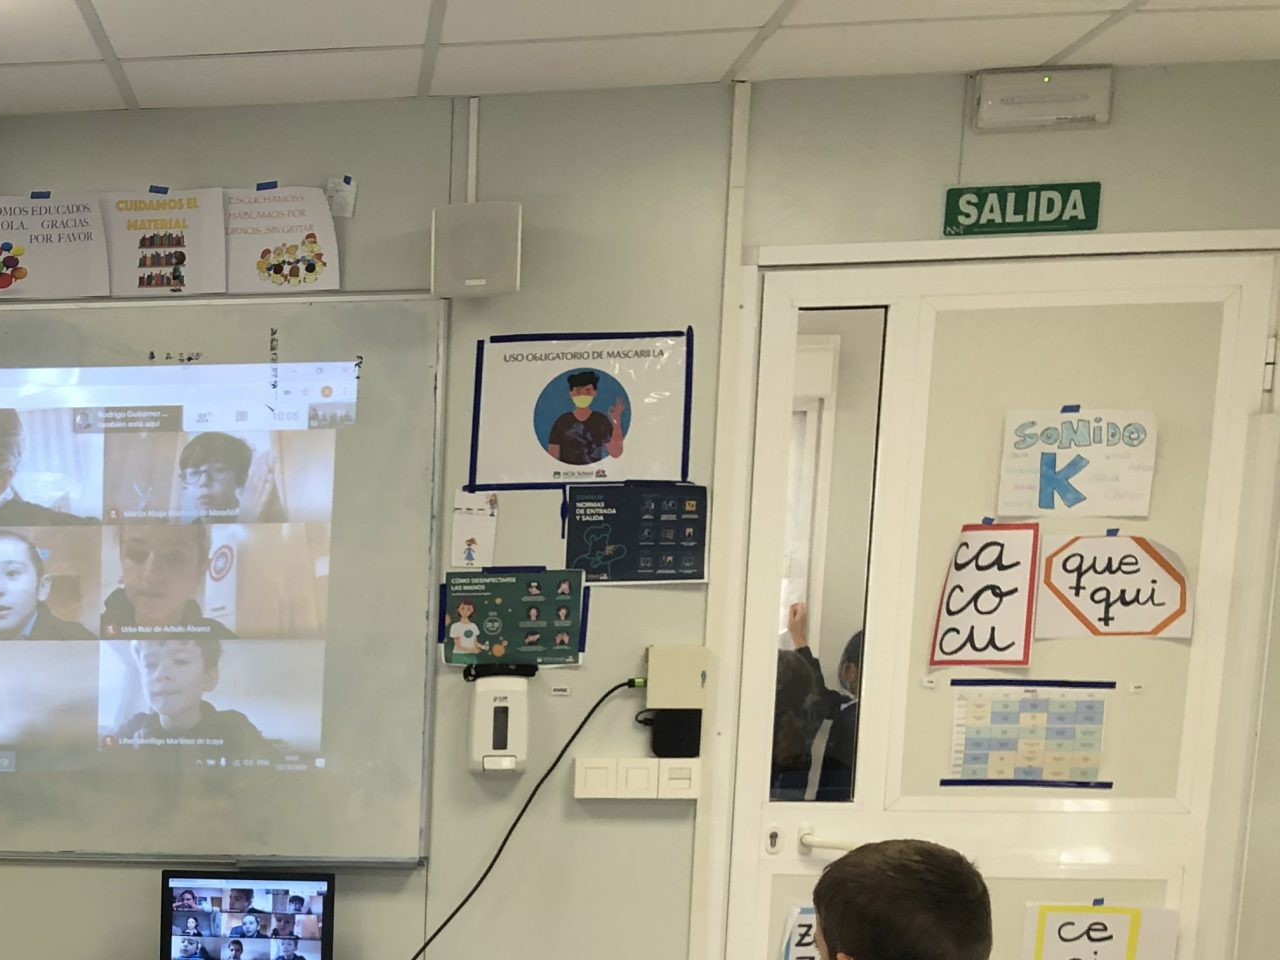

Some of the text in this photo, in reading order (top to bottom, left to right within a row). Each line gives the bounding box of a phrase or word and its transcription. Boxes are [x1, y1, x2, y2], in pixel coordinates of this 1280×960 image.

[116, 199, 184, 212] CUIDAMOS
[957, 189, 1087, 227] SALIDA
[29, 231, 94, 245] POR FAVOR
[127, 217, 189, 231] MATERIAL
[503, 348, 664, 363] USO OBLIGATORIO DE MASCARILLA
[1038, 451, 1090, 509] K
[953, 541, 1021, 572] ca
[1061, 552, 1141, 597] que
[945, 584, 1019, 616] co
[1089, 579, 1166, 627] qui
[938, 625, 1016, 656] cu
[1057, 921, 1114, 943] ce
